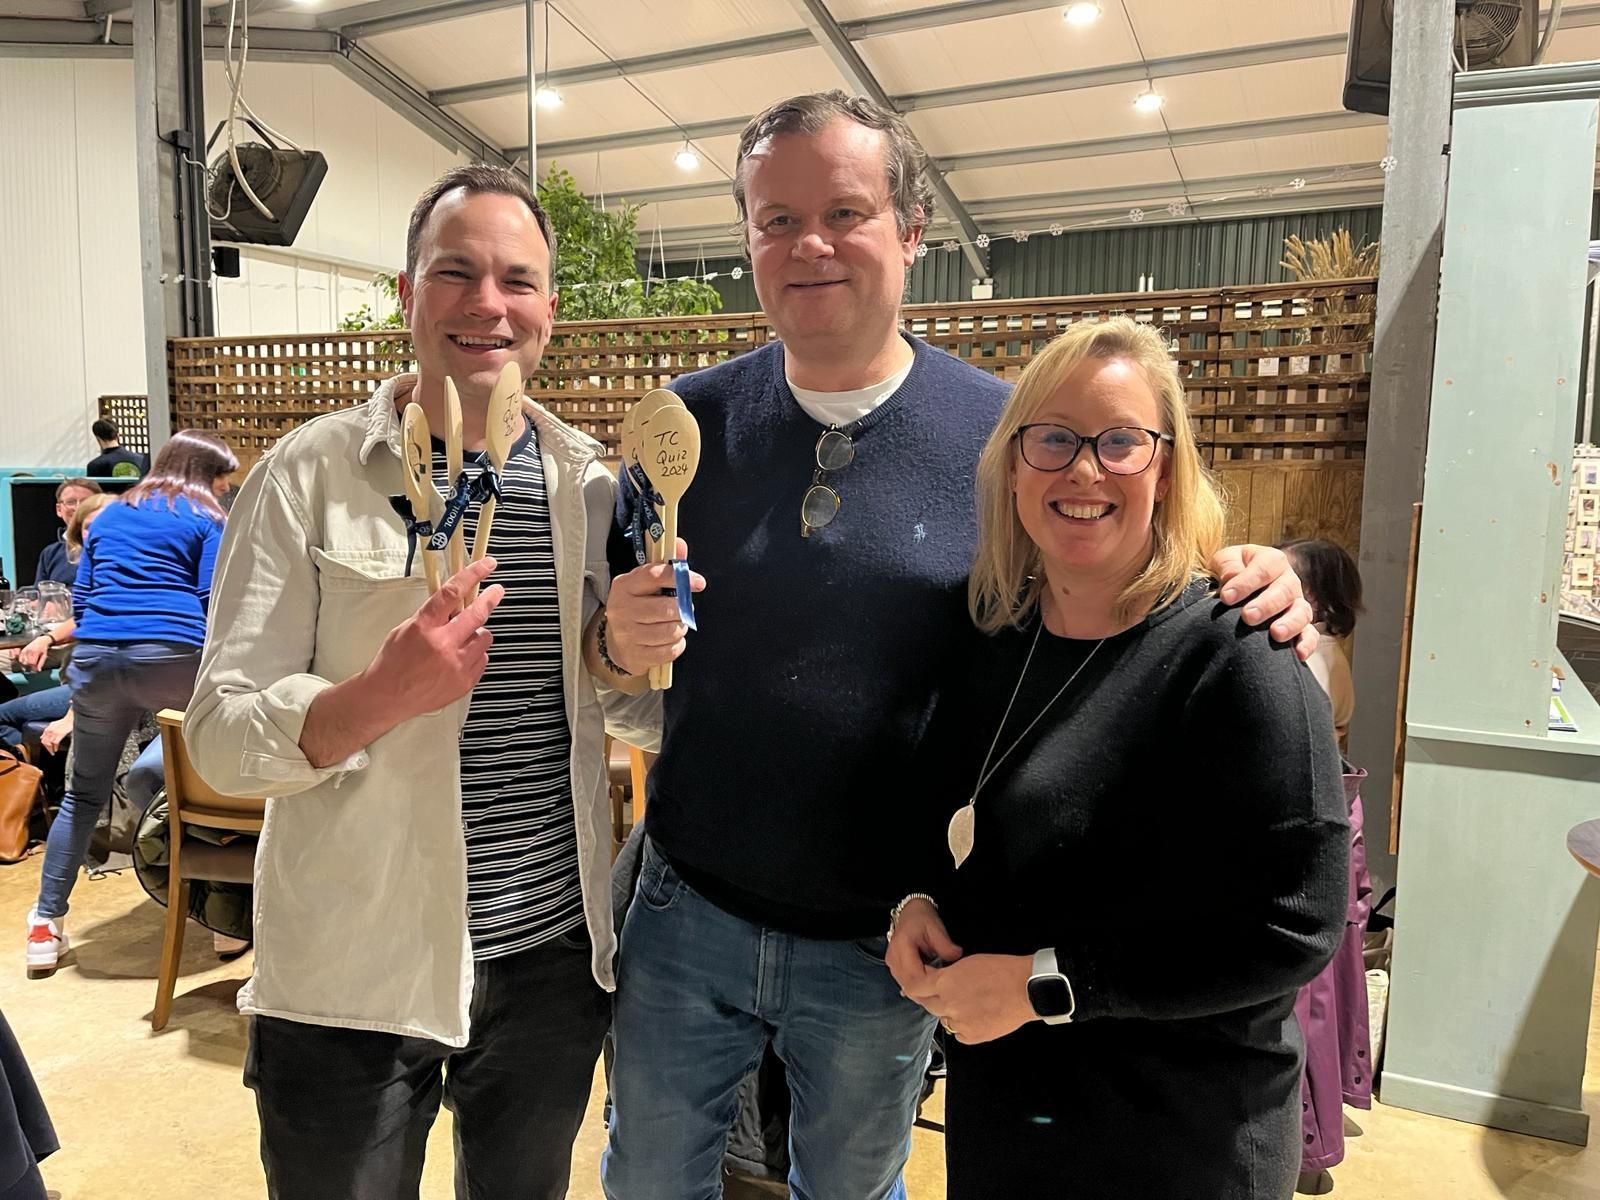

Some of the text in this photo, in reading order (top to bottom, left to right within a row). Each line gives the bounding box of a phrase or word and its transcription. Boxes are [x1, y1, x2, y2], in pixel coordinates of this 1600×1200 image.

[654, 430, 679, 446] TC
[656, 449, 688, 466] Quiz
[661, 463, 688, 477] 2024
